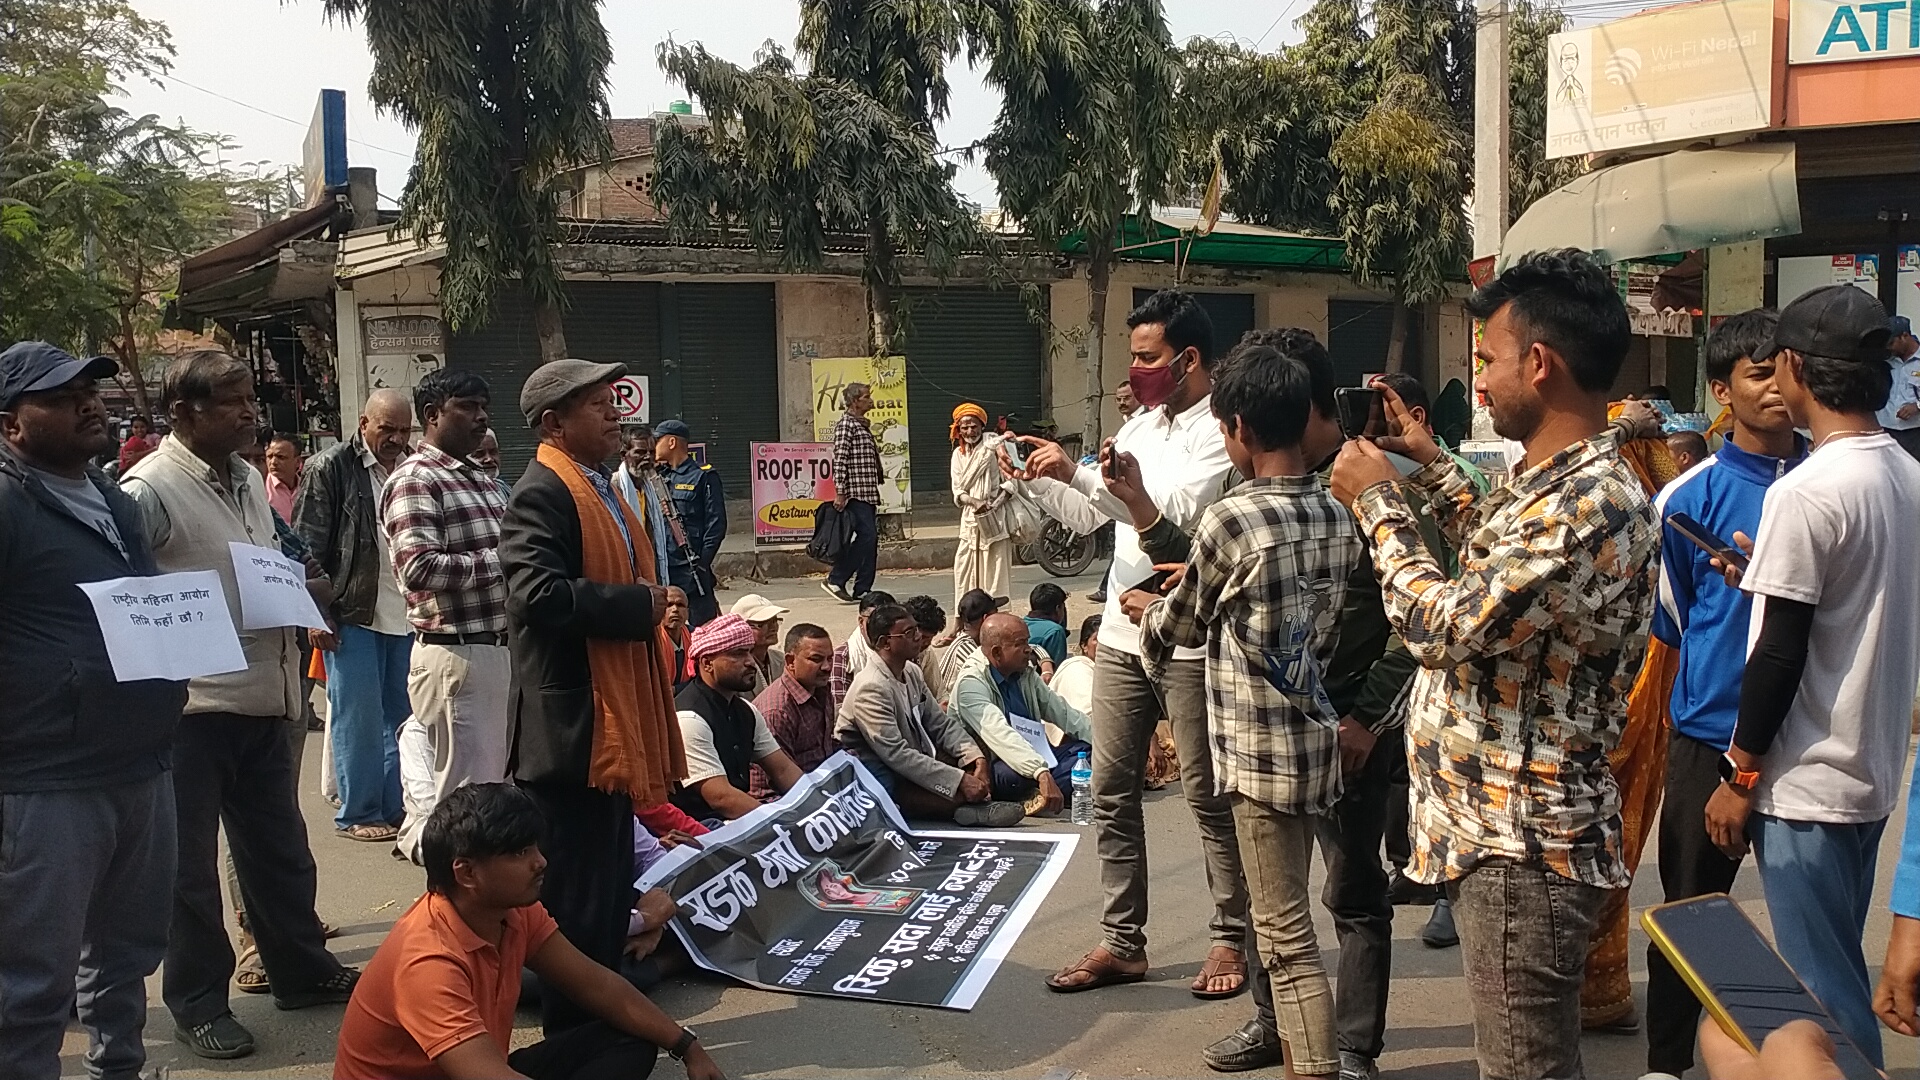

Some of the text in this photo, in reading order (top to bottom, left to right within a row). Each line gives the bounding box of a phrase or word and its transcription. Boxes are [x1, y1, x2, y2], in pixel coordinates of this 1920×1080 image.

[1651, 30, 1757, 61] Wi-Fi Nepal
[1550, 117, 1668, 148] जनक पान पसल
[366, 320, 442, 335] NEW LOOK
[757, 458, 803, 481] ROOF
[111, 588, 210, 607] राष्ट्रीय महिला आयोग
[130, 613, 151, 627] तिमि
[676, 858, 758, 932] सडक
[879, 922, 934, 954] सदा
[909, 890, 963, 922] लाई
